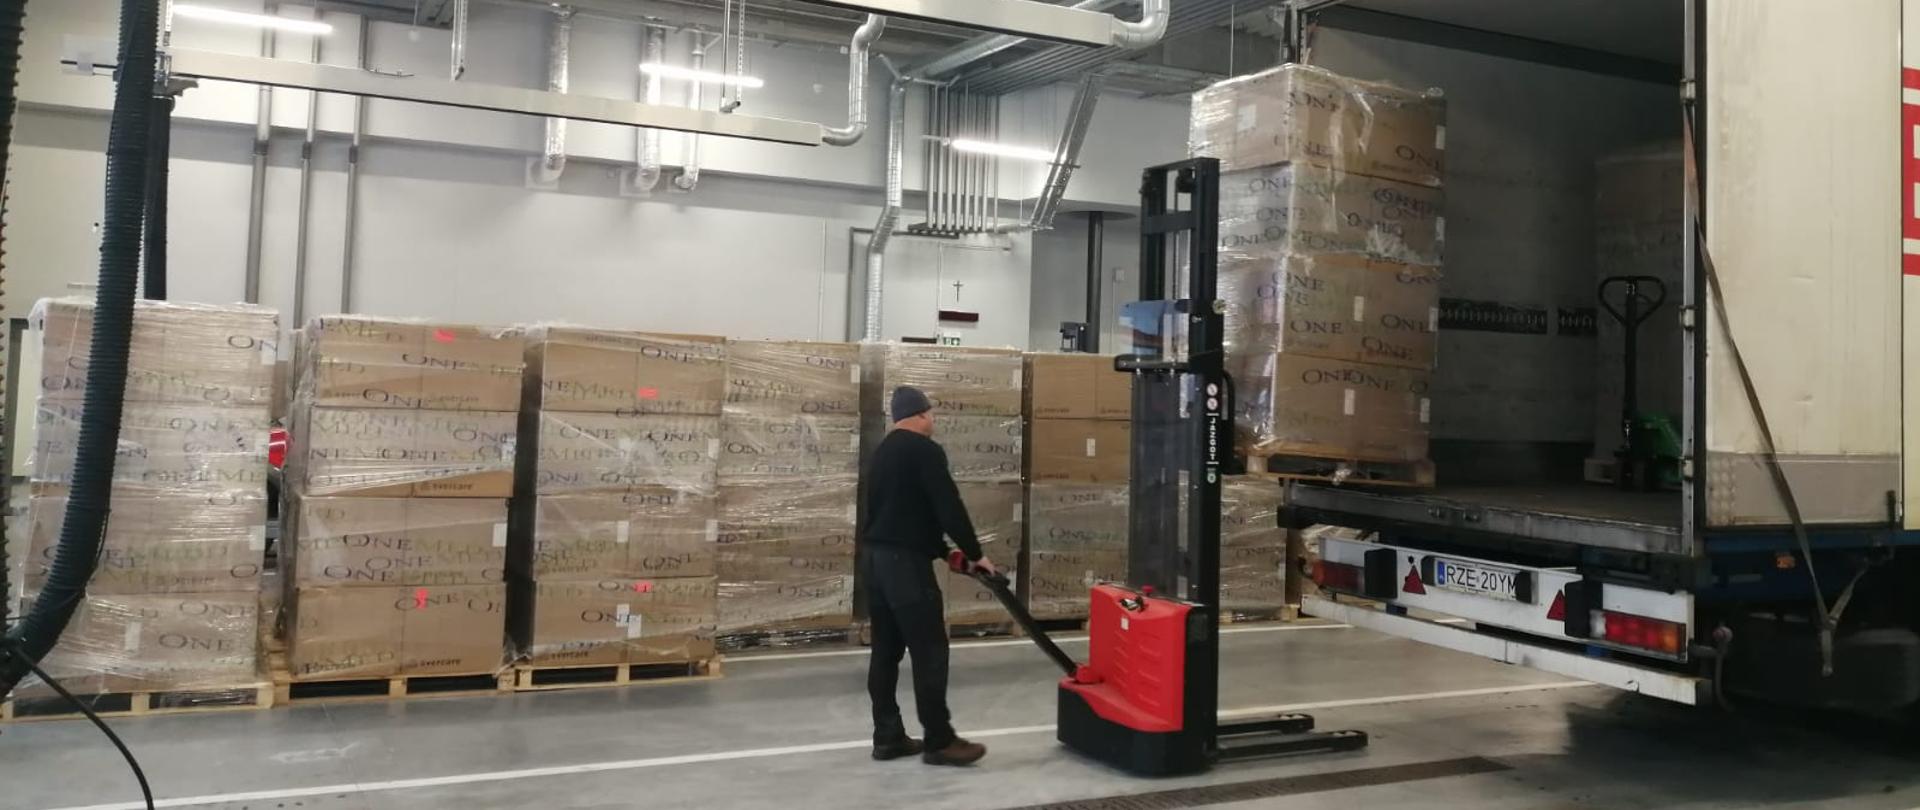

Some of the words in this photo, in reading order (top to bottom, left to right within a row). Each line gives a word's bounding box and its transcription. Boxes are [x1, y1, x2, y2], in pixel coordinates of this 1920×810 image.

[1290, 320, 1344, 335] ONE
[1361, 335, 1413, 361] ONE
[1446, 565, 1477, 588] RZE
[158, 632, 234, 652] ONE
